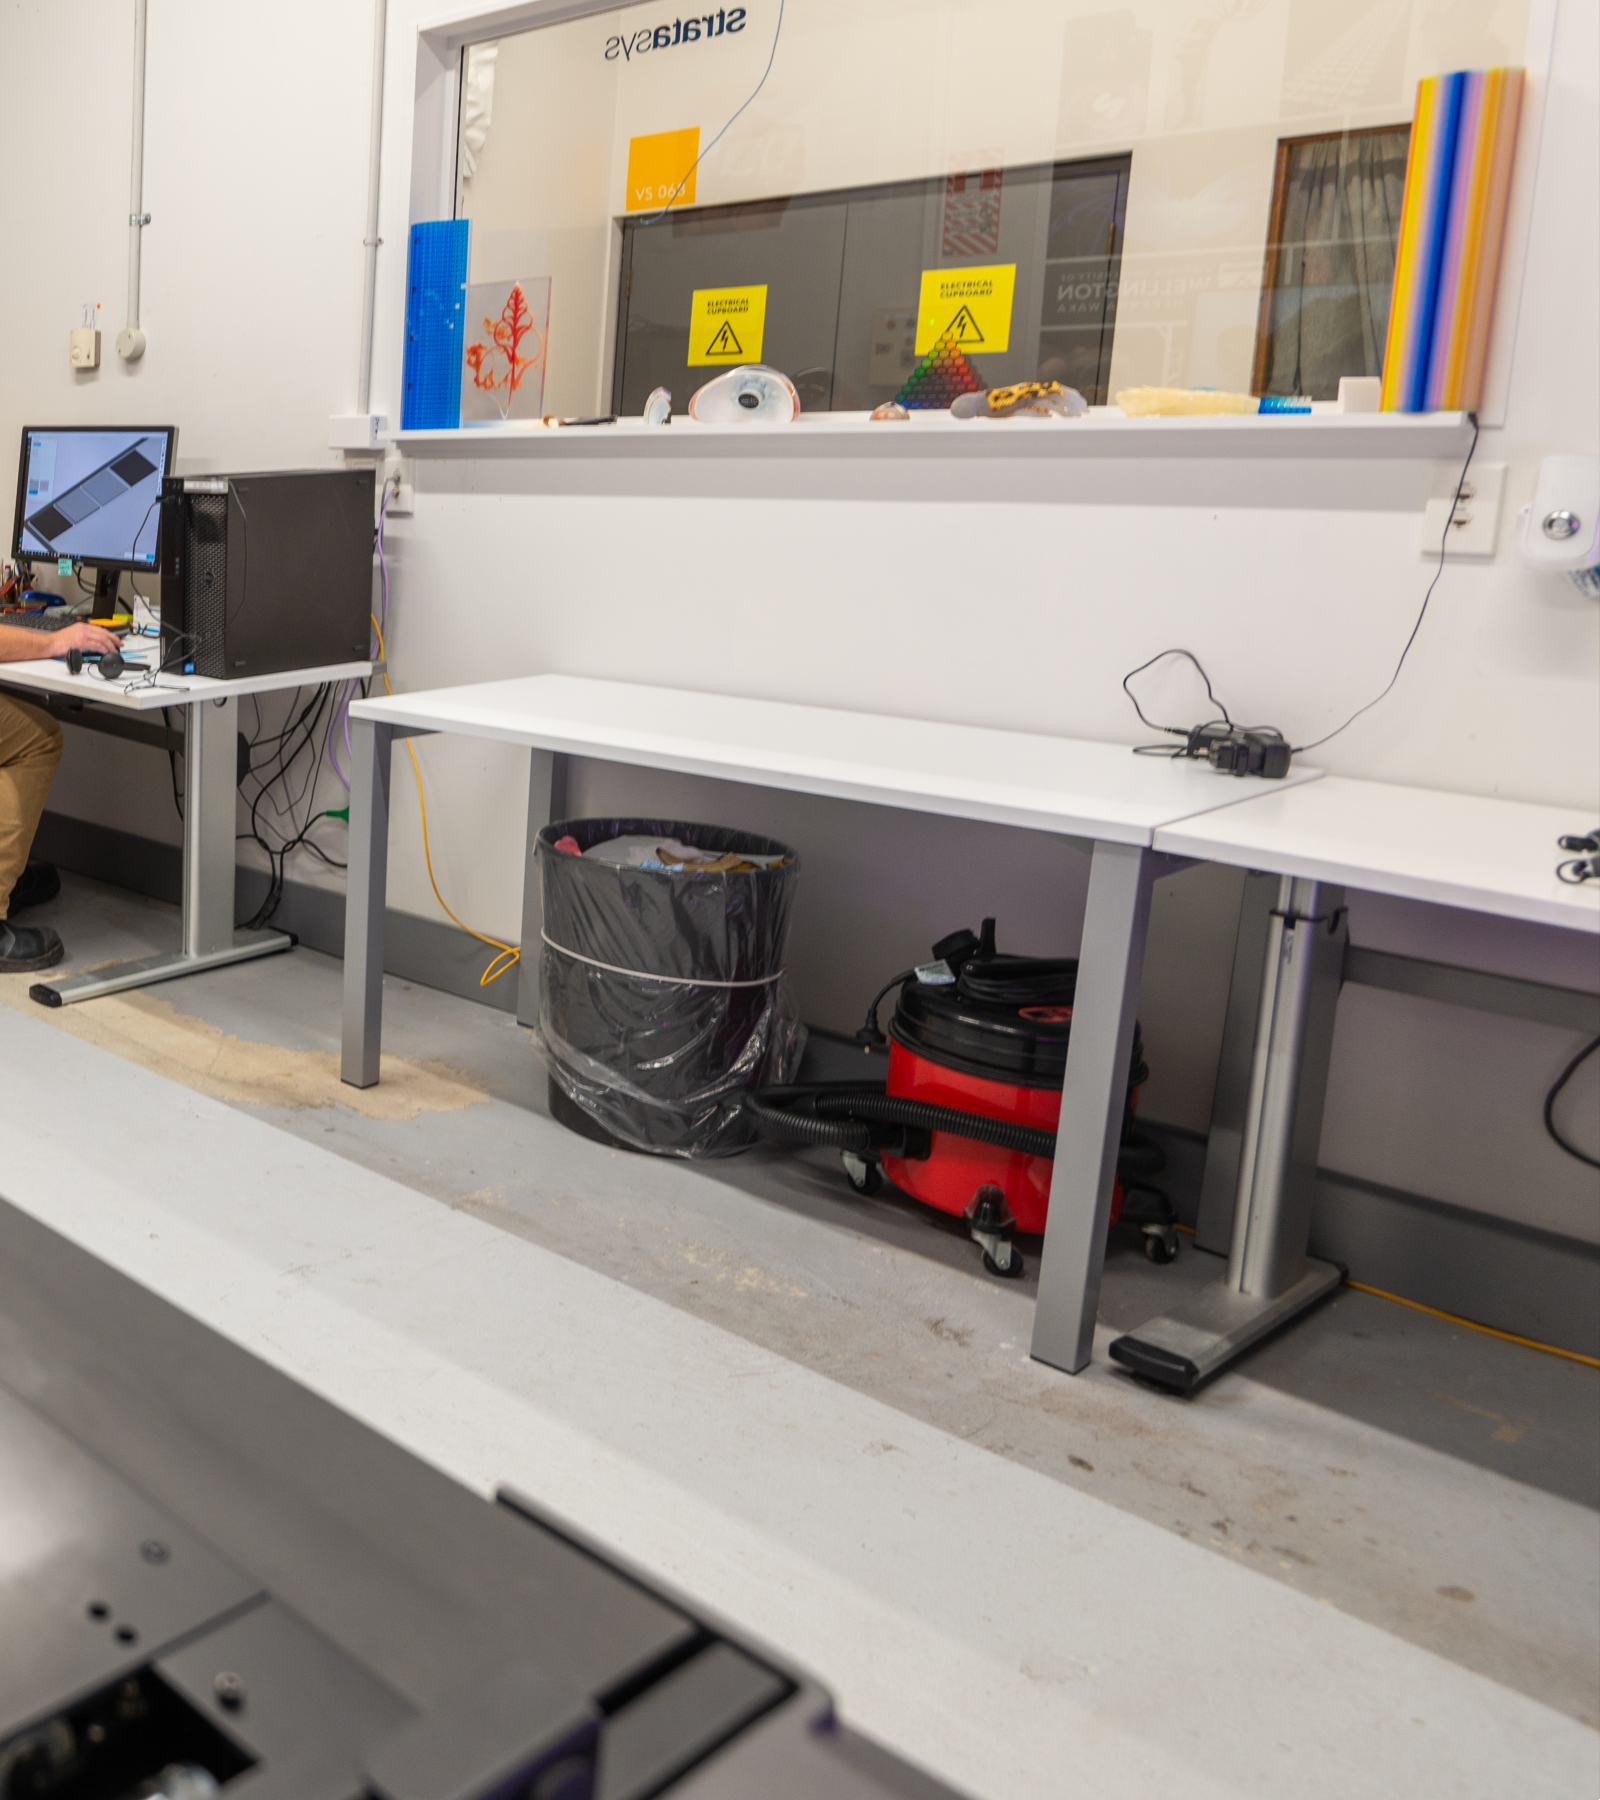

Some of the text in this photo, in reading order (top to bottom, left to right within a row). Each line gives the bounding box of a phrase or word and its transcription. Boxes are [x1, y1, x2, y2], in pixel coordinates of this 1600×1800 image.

[635, 186, 653, 202] VS
[940, 279, 993, 290] ELECTRICAL
[940, 287, 993, 299] CUPBOARD
[707, 297, 749, 307] ELECTRICAL
[707, 305, 749, 315] CUPBOARD
